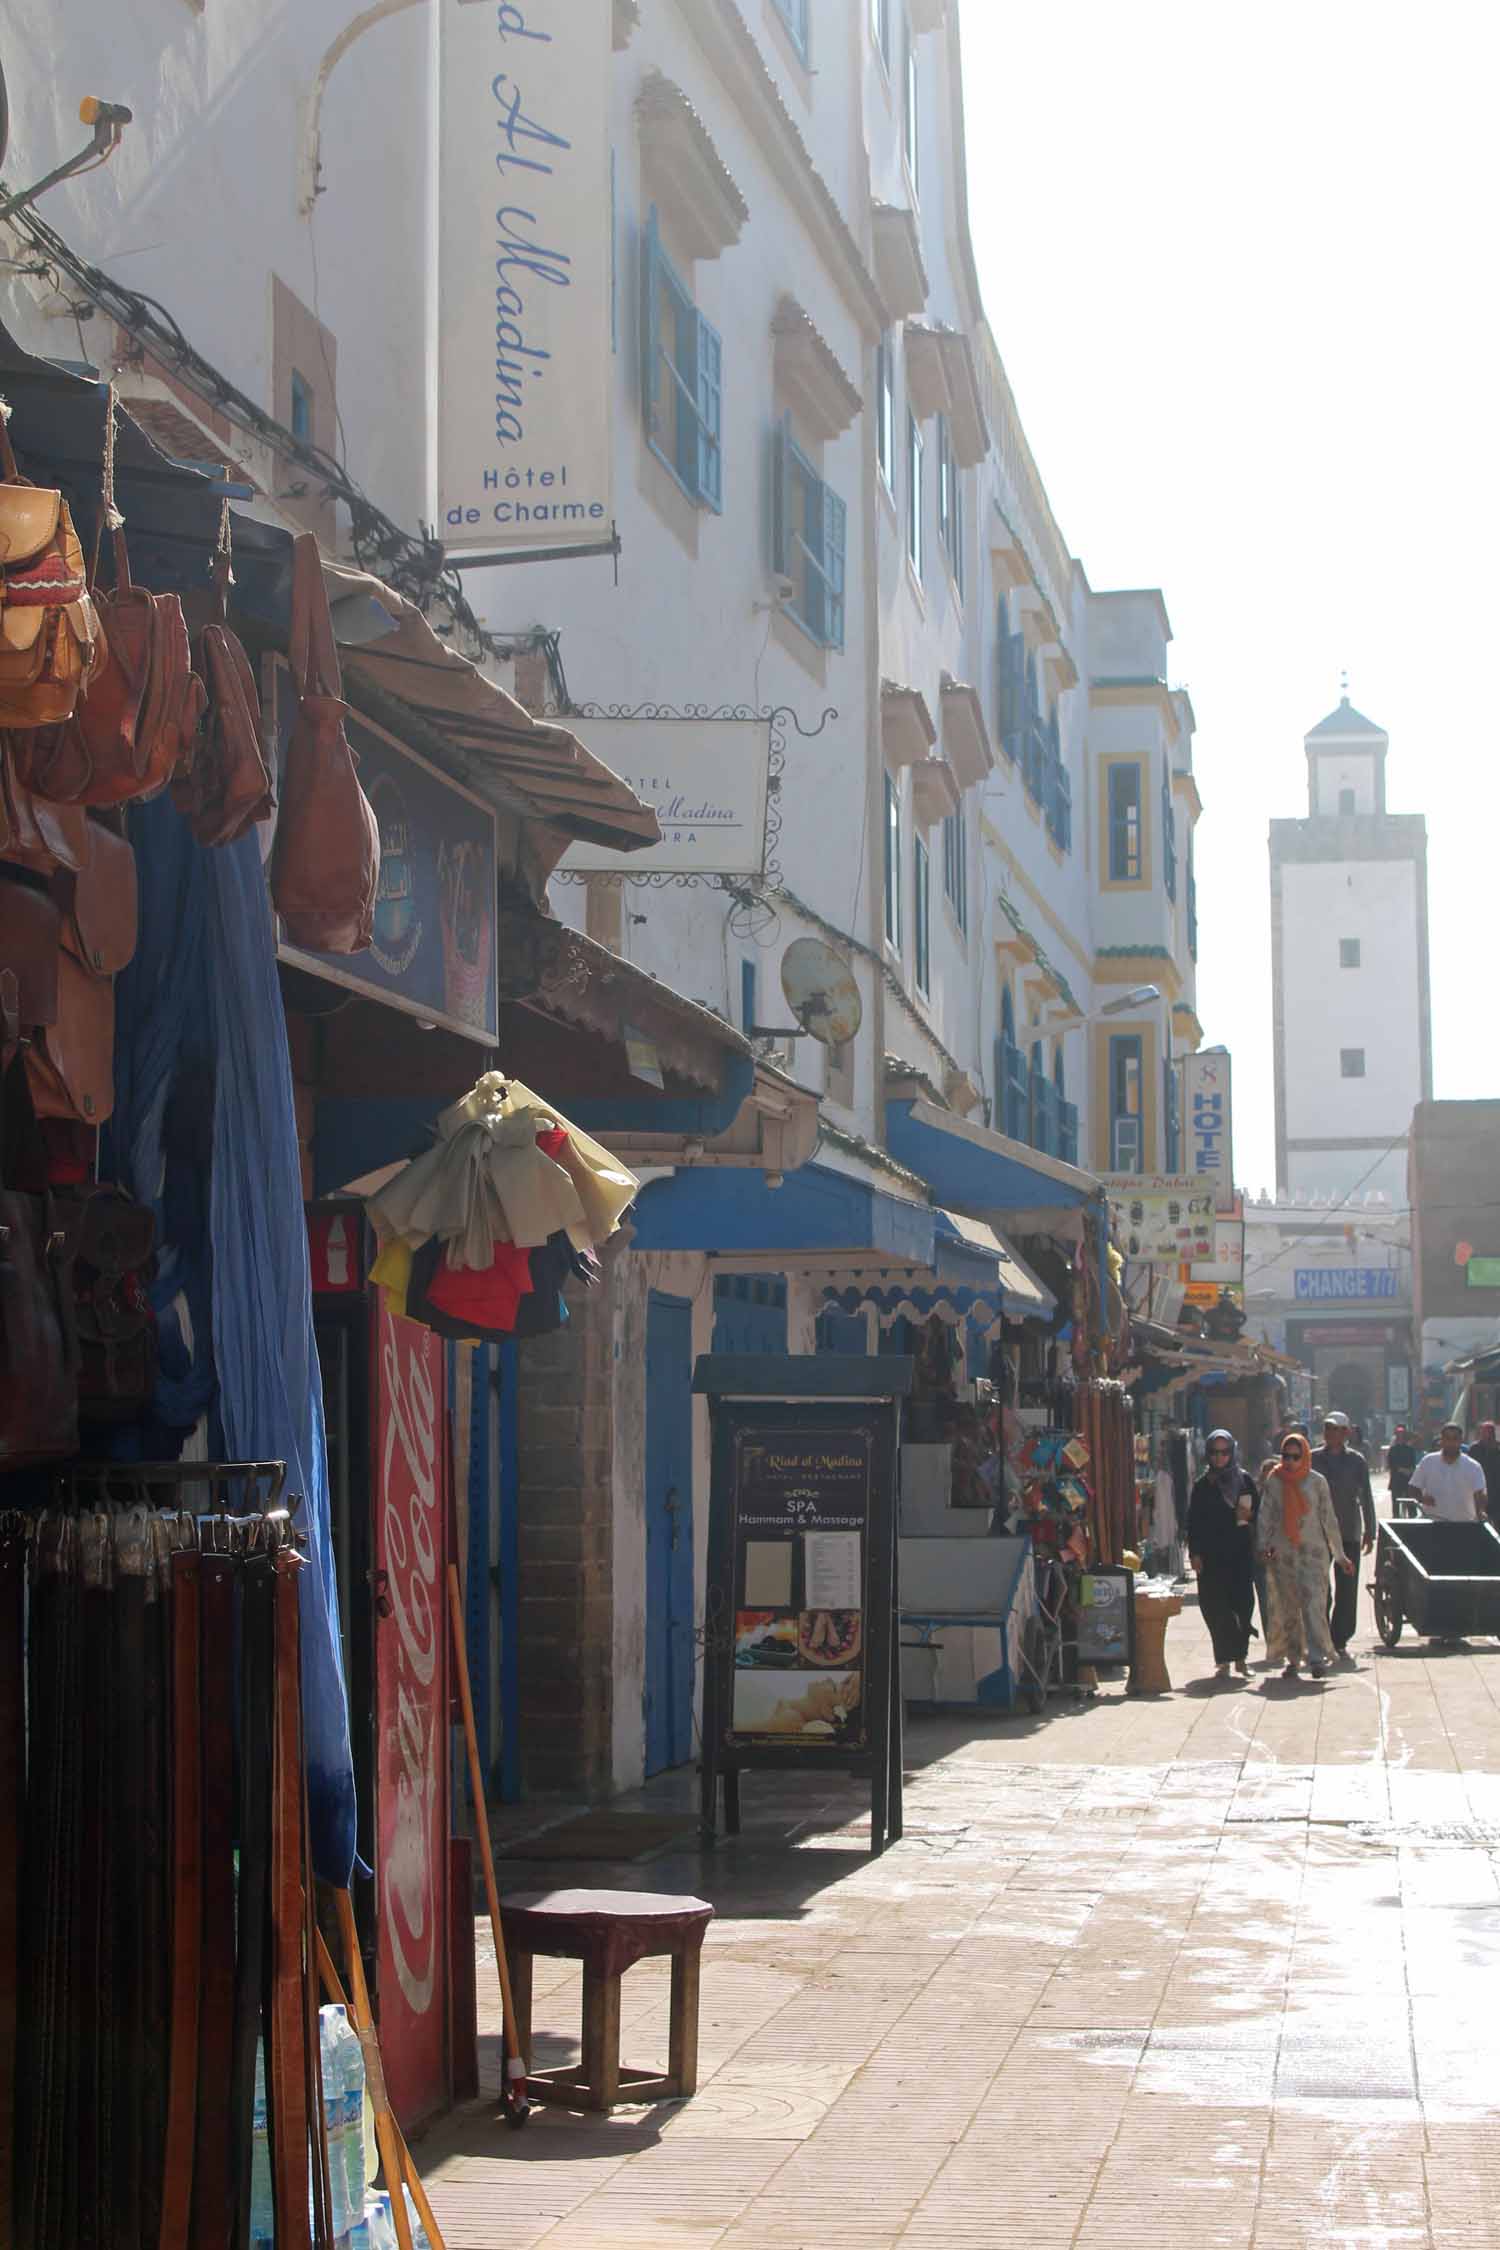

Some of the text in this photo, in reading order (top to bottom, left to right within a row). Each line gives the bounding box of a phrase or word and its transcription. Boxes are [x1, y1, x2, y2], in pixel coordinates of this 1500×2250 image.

[491, 74, 571, 176] Al
[495, 206, 571, 448] Madina
[483, 465, 566, 489] Hôtel
[447, 502, 604, 525] de Charme
[656, 796, 736, 819] Madina
[1193, 1092, 1223, 1175] HOTE
[1297, 1272, 1367, 1297] CHANGE
[769, 1455, 799, 1470] Riad
[786, 1500, 817, 1512] SPA
[738, 1513, 864, 1526] Hammam & Massage
